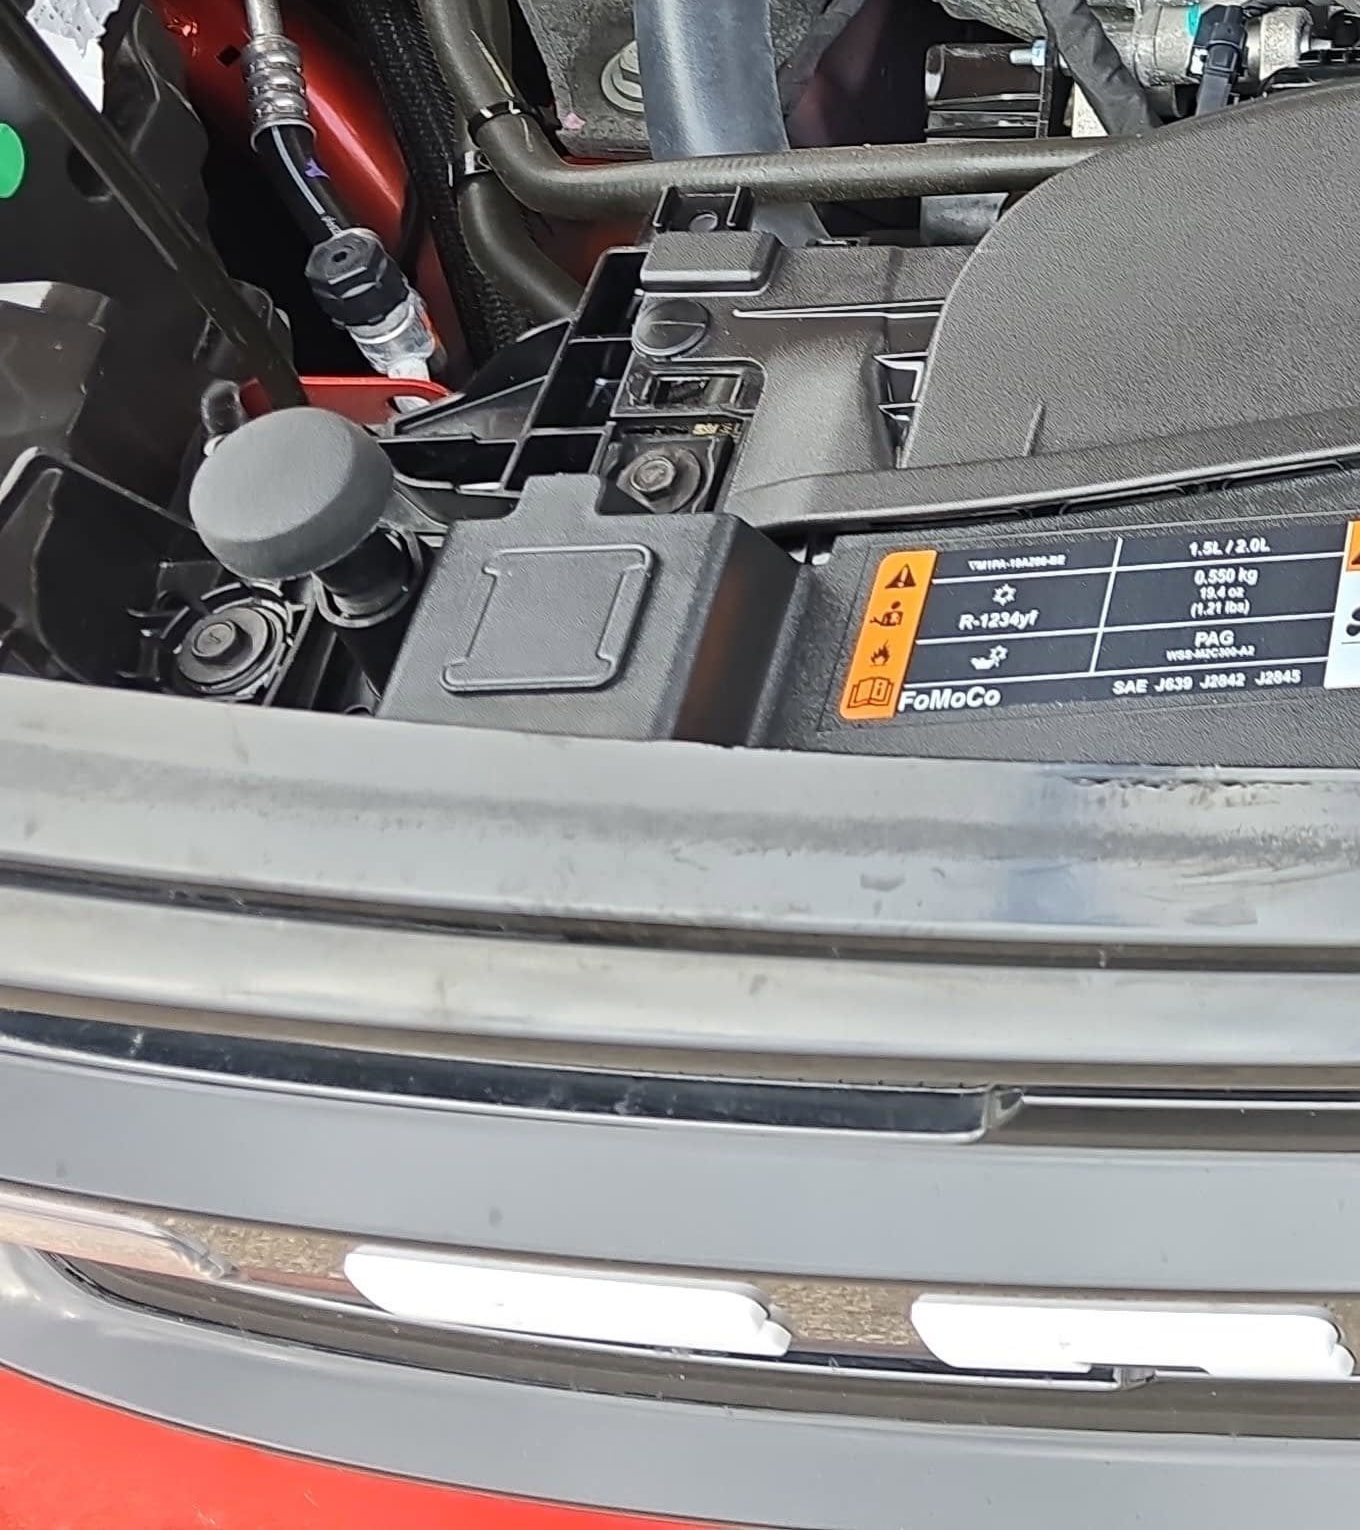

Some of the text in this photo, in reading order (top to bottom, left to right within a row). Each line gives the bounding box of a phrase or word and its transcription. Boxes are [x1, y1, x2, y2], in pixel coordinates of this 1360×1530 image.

[1189, 540, 1223, 557] 1.5L
[1235, 537, 1271, 554] 2.0L
[1194, 567, 1259, 586] 0.550 kg
[1199, 586, 1245, 600] 19.4 oz
[1224, 599, 1250, 617] lbs)
[958, 608, 1040, 630] R-1234yf
[1194, 630, 1235, 648] PAG
[1112, 678, 1149, 695] SAE
[1154, 676, 1194, 693] J639
[897, 686, 1001, 712] FoMoCo
